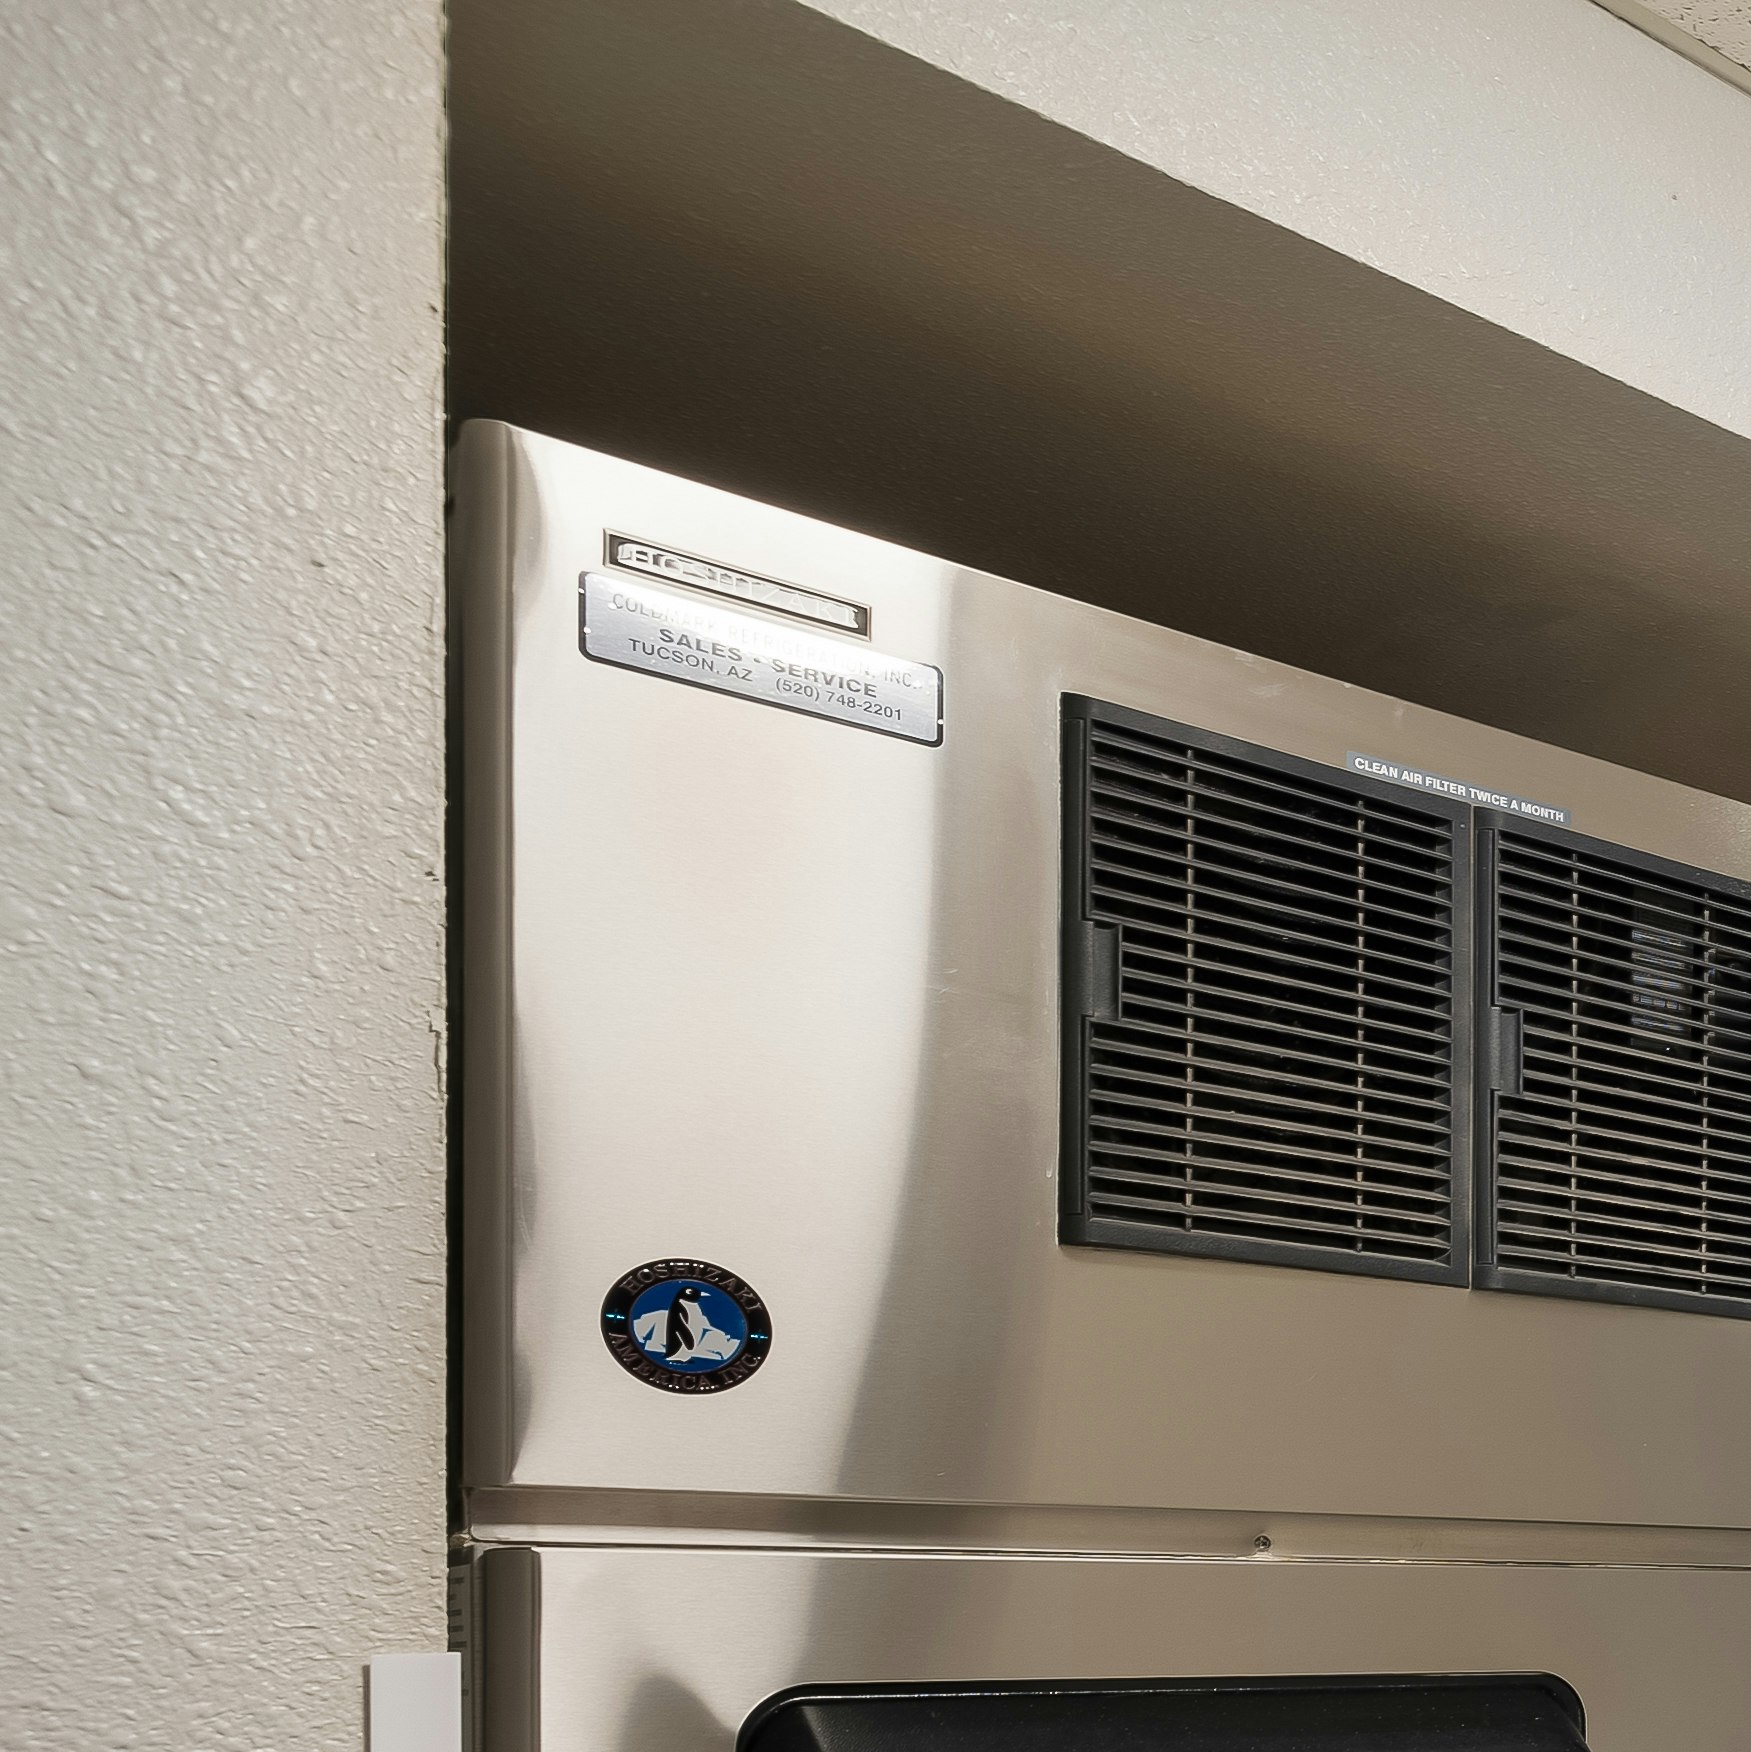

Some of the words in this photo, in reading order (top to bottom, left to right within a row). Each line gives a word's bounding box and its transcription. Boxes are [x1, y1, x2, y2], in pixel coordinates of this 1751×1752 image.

[628, 638, 720, 675] TUCSON,
[727, 664, 753, 682] AZ
[658, 629, 743, 662] SALES
[771, 658, 877, 699] SERVICE
[775, 677, 820, 702] (520)
[826, 689, 903, 721] 748-2201
[1354, 756, 1398, 779] CLEAN
[1401, 770, 1423, 785] AIR
[1425, 777, 1466, 797] FILTER
[1469, 787, 1508, 808] TWICE
[1510, 799, 1519, 811] A
[1521, 801, 1564, 822] MONTH
[619, 1262, 763, 1311] HOSHIZAKI
